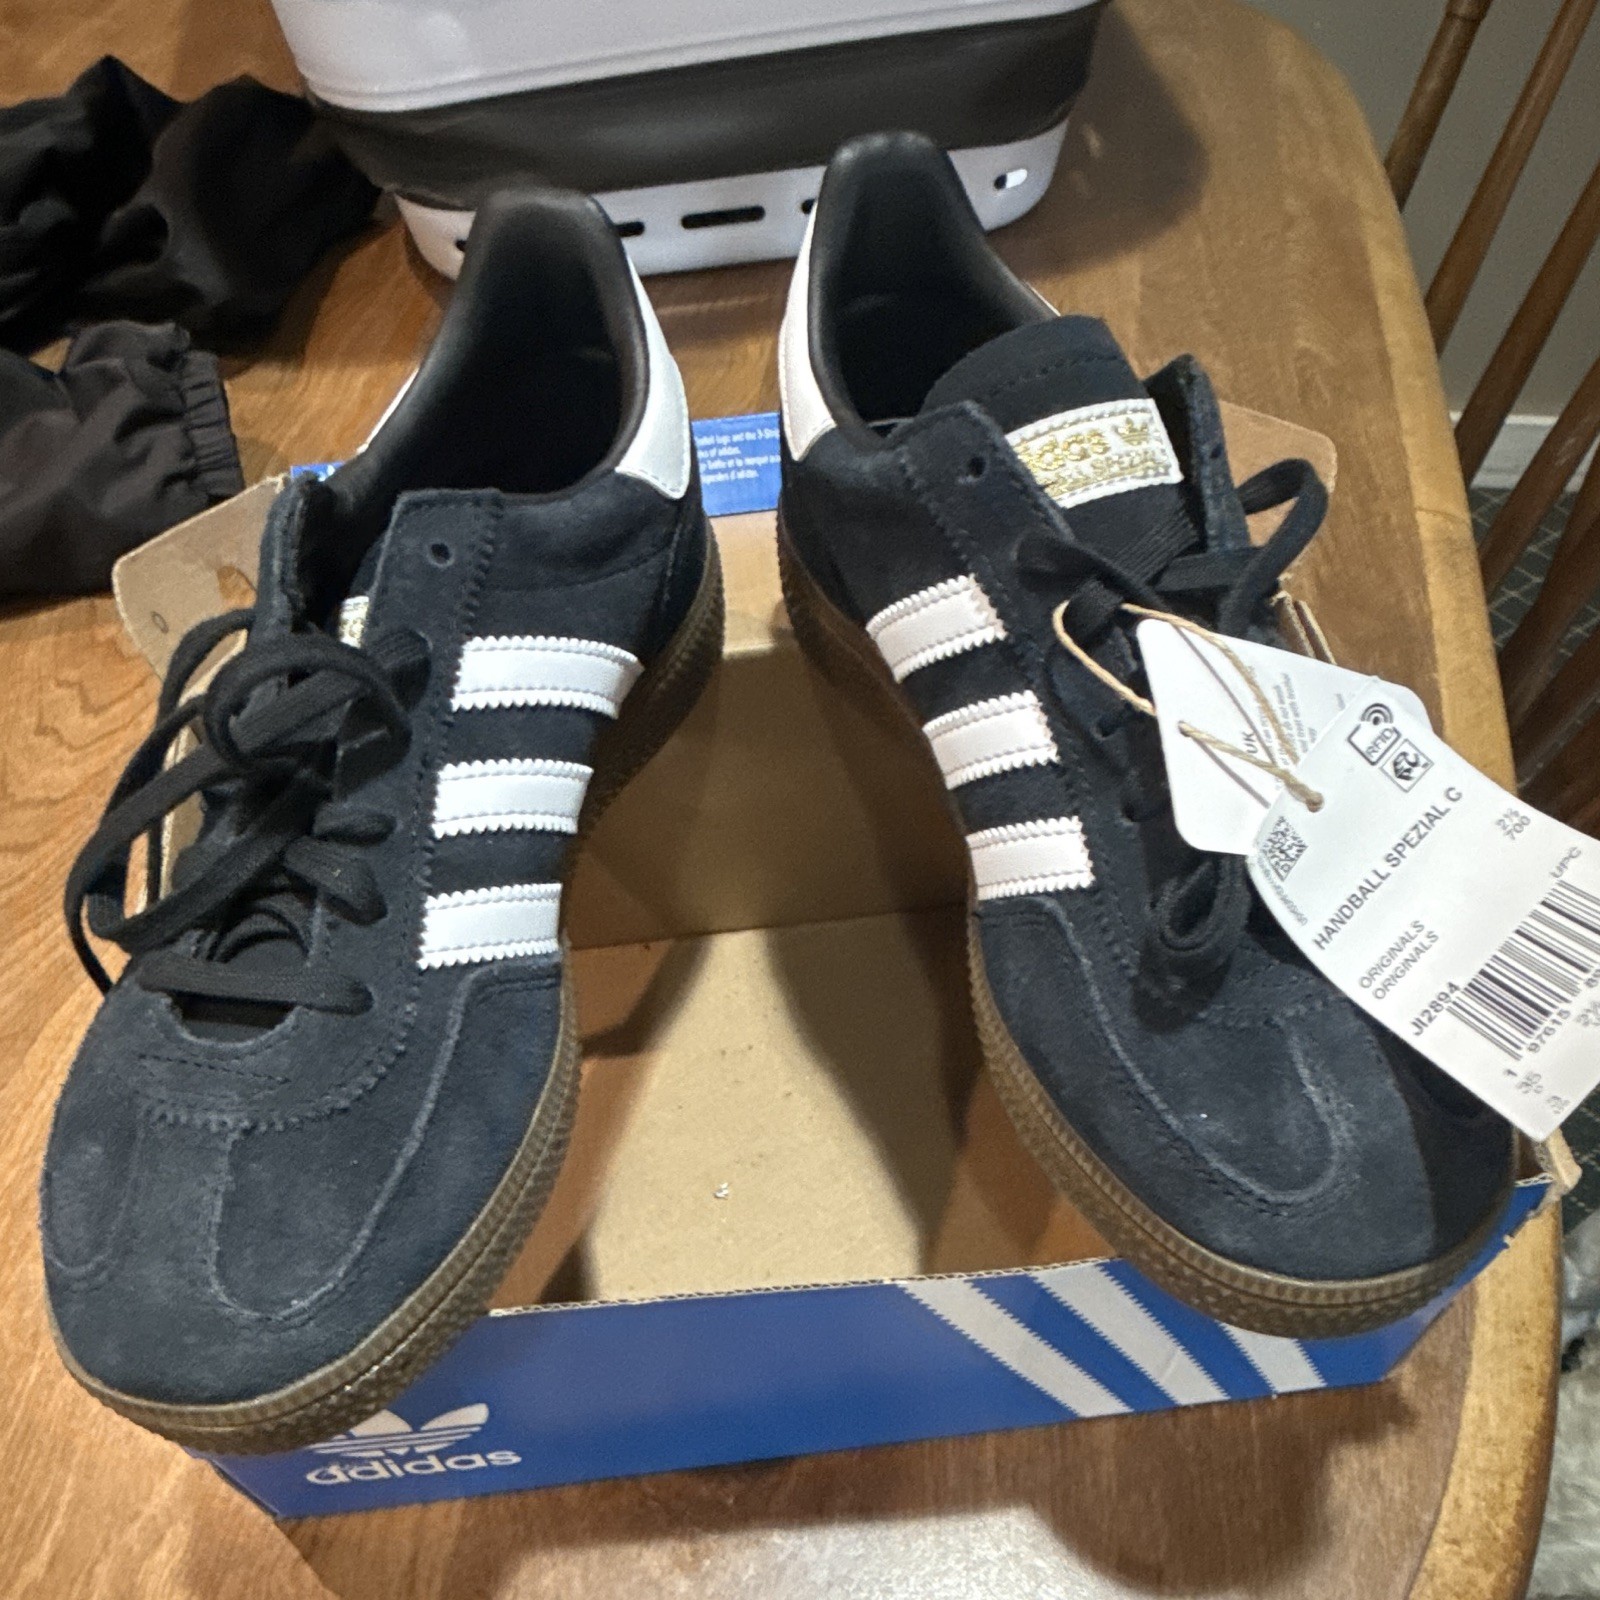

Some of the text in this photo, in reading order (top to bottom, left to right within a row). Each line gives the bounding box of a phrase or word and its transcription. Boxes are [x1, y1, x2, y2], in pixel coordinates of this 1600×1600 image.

[1241, 731, 1259, 754] UK
[1365, 727, 1394, 758] RFID
[1503, 816, 1531, 840] 700
[1312, 869, 1392, 950] HANDBALL
[1383, 805, 1451, 868] SPEZIAL
[1549, 846, 1582, 878] UPC
[1358, 920, 1425, 989] ORIGINALS
[1372, 930, 1439, 1000] ORIGINALS
[306, 1450, 522, 1485] adidas
